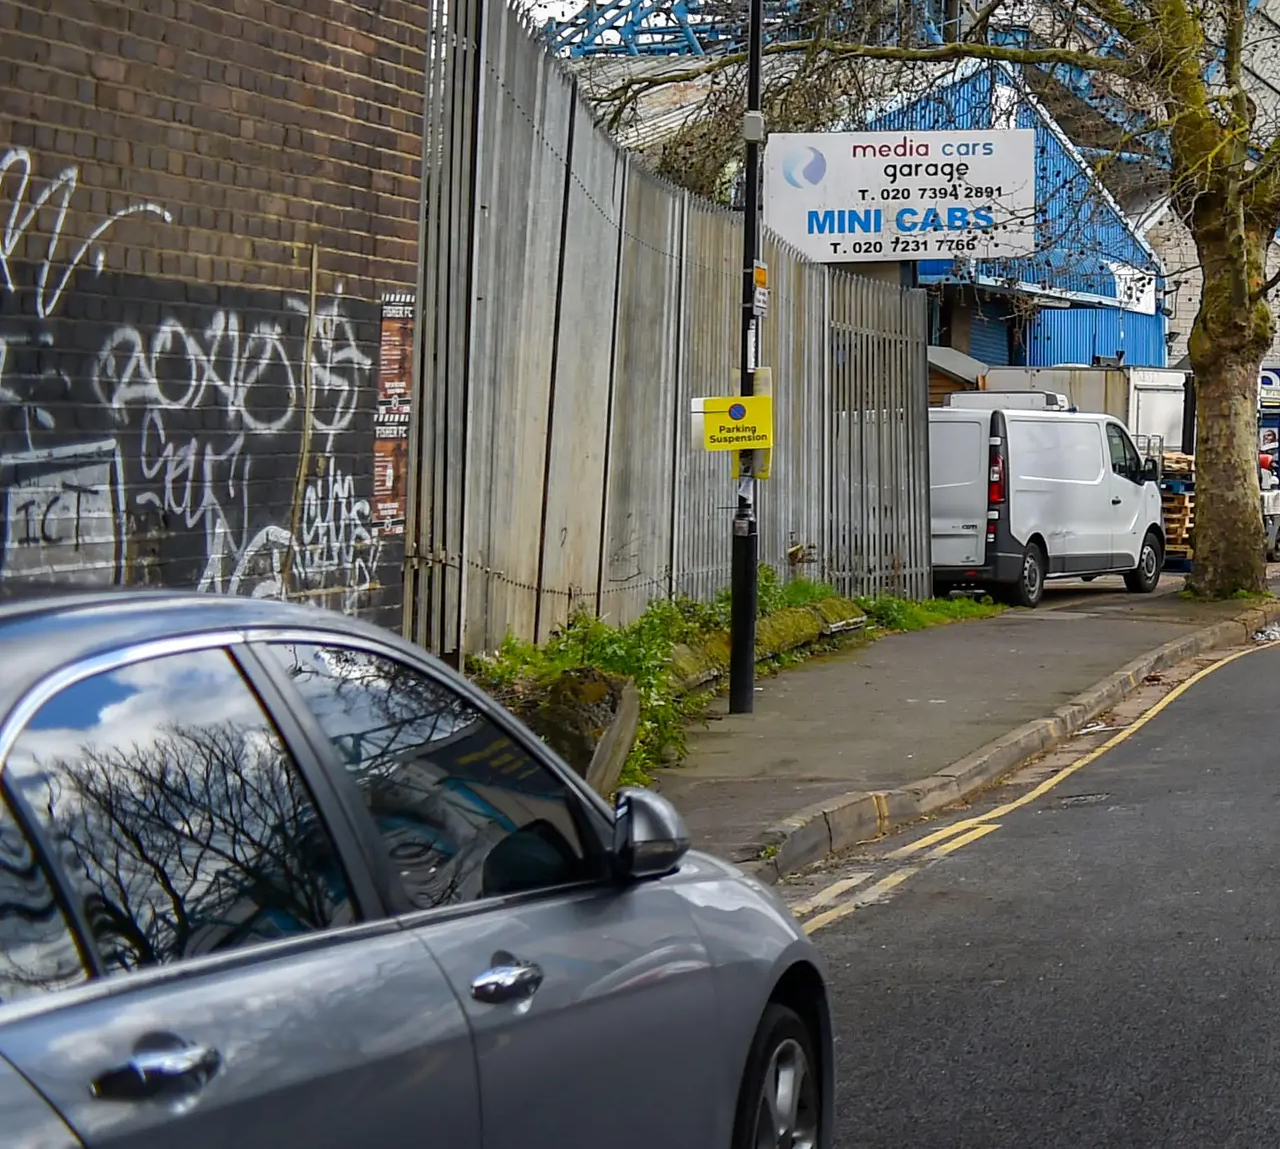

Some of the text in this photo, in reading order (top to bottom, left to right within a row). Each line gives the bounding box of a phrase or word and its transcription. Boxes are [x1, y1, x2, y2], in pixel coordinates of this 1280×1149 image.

[852, 136, 994, 158] media cars
[884, 162, 969, 183] garage
[858, 186, 1002, 201] T. 020 7394 2891
[808, 207, 995, 234] MINI CABS
[830, 239, 976, 254] T. 020 7231 7766
[719, 424, 757, 434] Parking
[709, 434, 768, 444] Suspension
